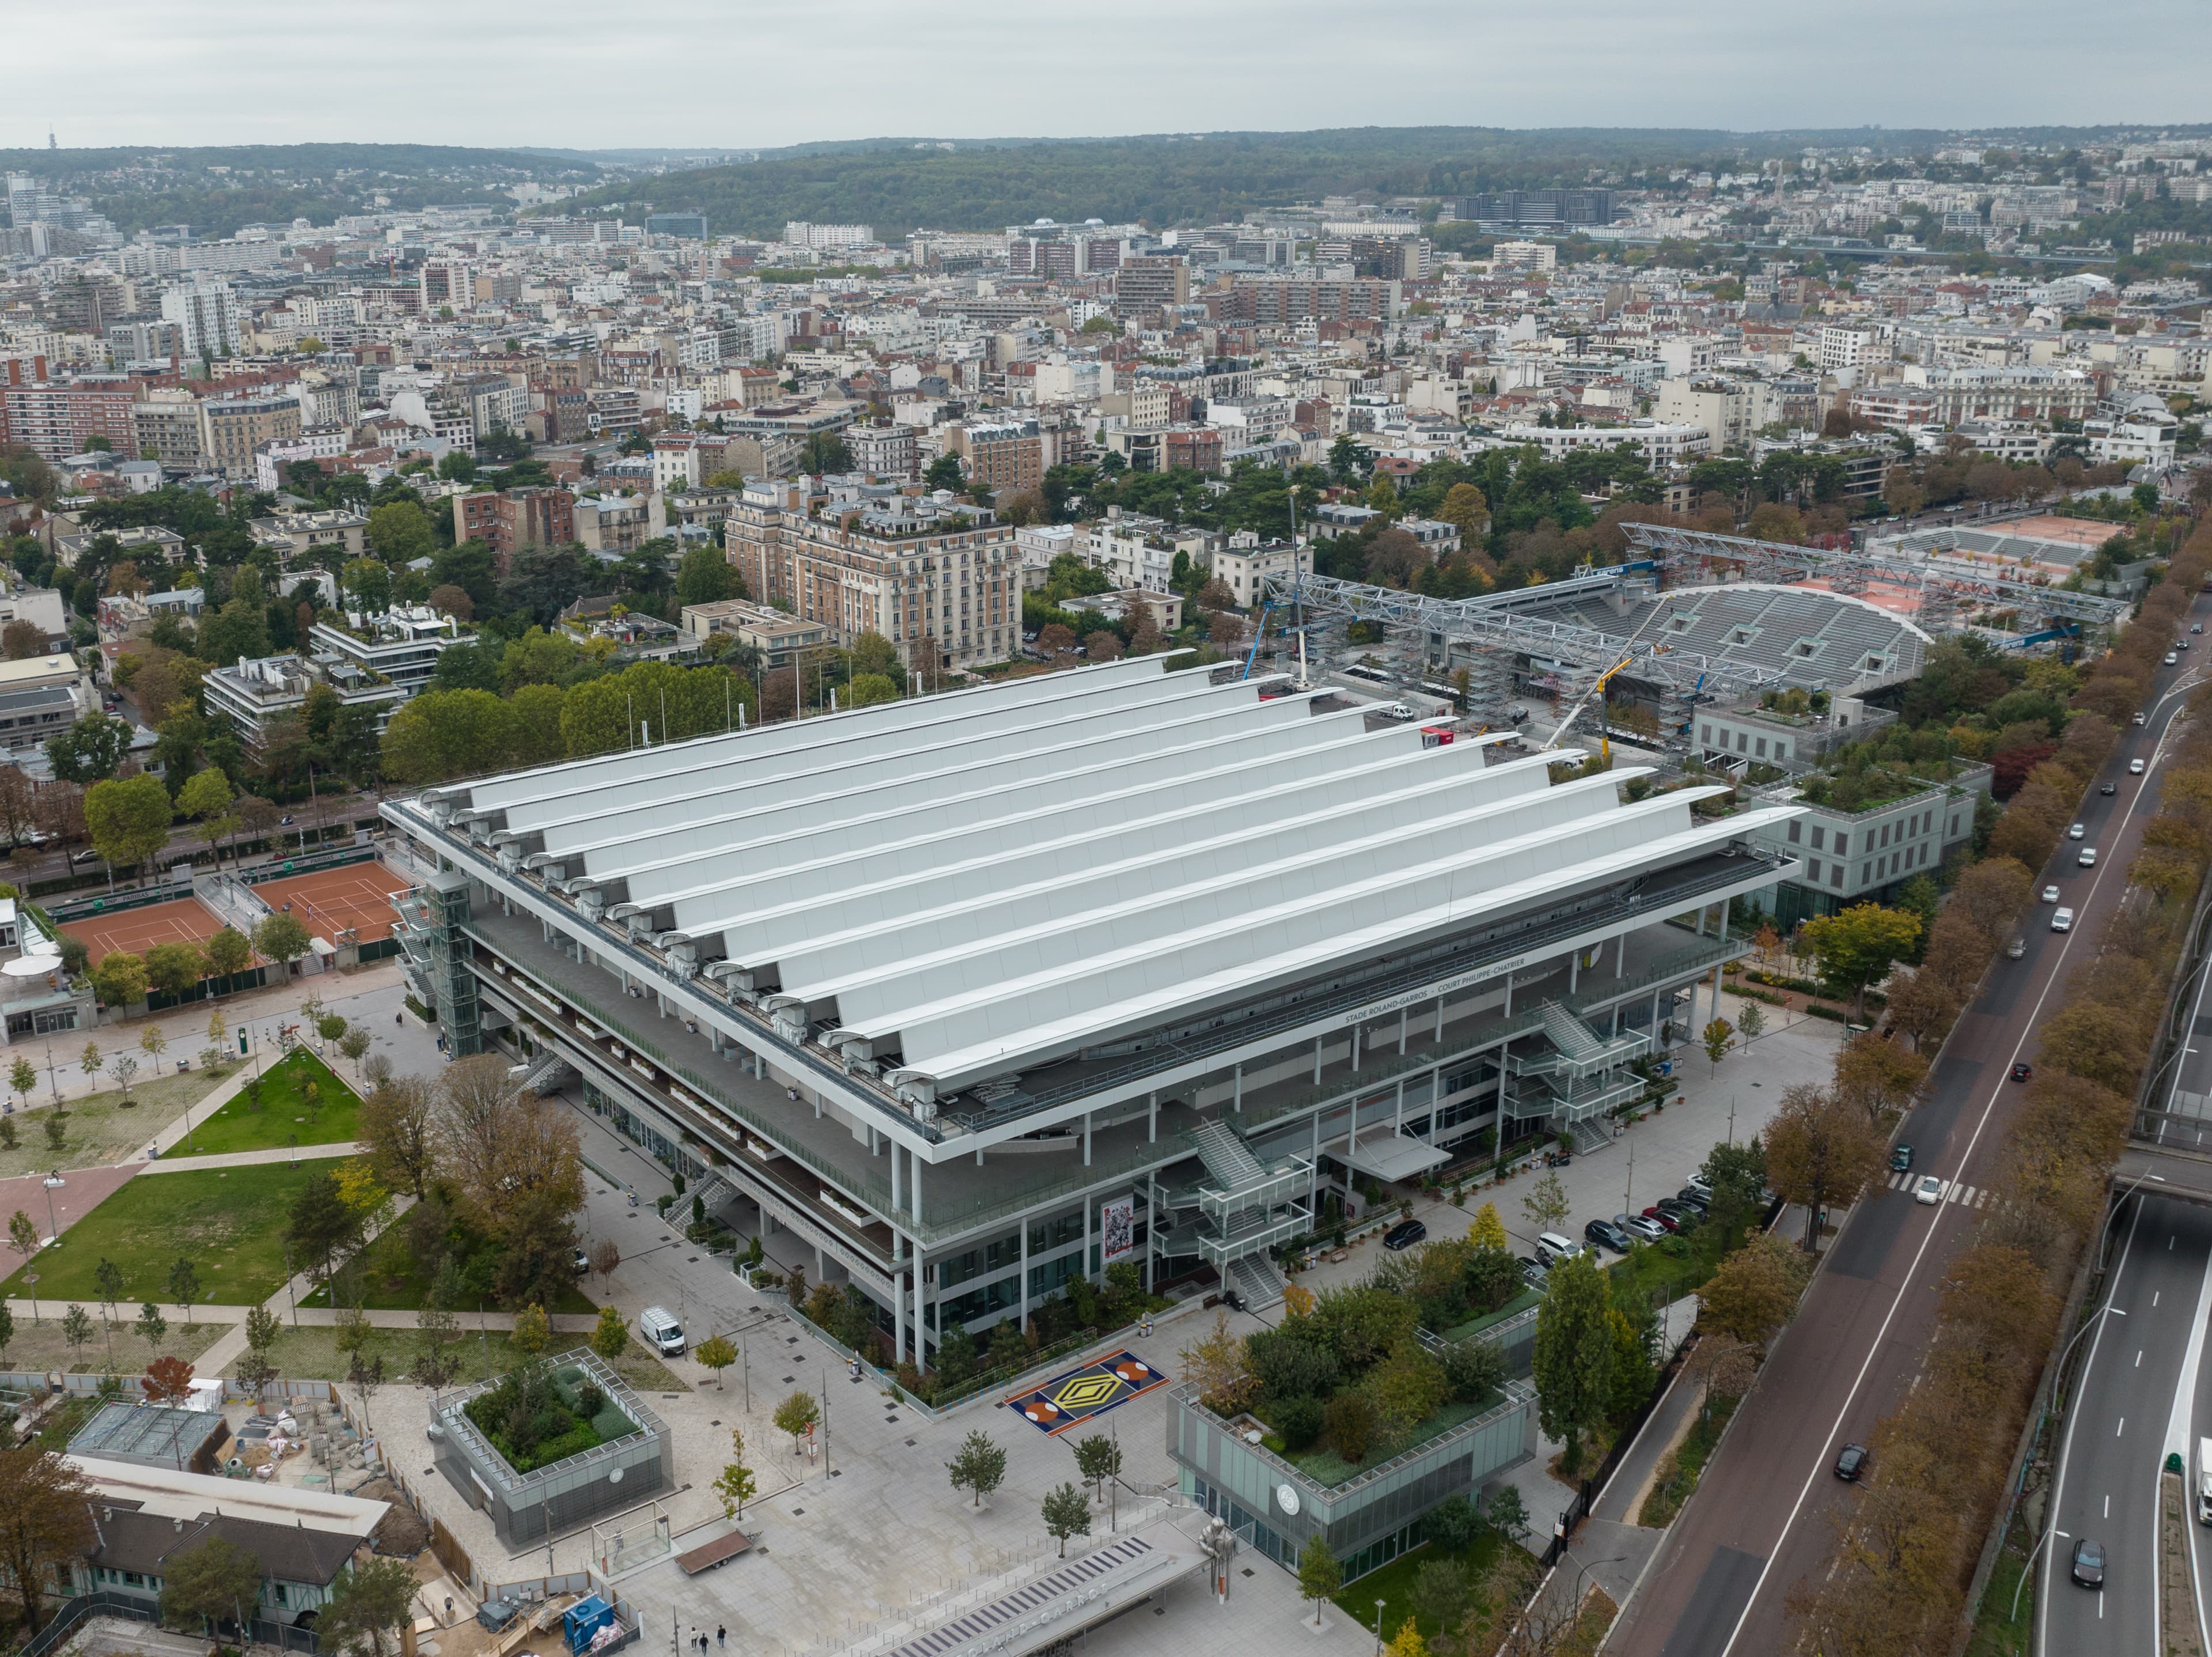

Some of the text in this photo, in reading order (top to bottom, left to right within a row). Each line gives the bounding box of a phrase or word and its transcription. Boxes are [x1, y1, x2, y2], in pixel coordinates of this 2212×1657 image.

[1596, 566, 1623, 576] sarens
[2001, 639, 2025, 650] arens
[310, 855, 334, 864] PARIBAS
[123, 892, 149, 901] PARIBAS
[1345, 1010, 1368, 1024] STADE
[1369, 990, 1427, 1016] ROLAND-GARROS
[1438, 978, 1461, 993] COURT
[1462, 958, 1525, 984] PHILIPPE-CHATRIER
